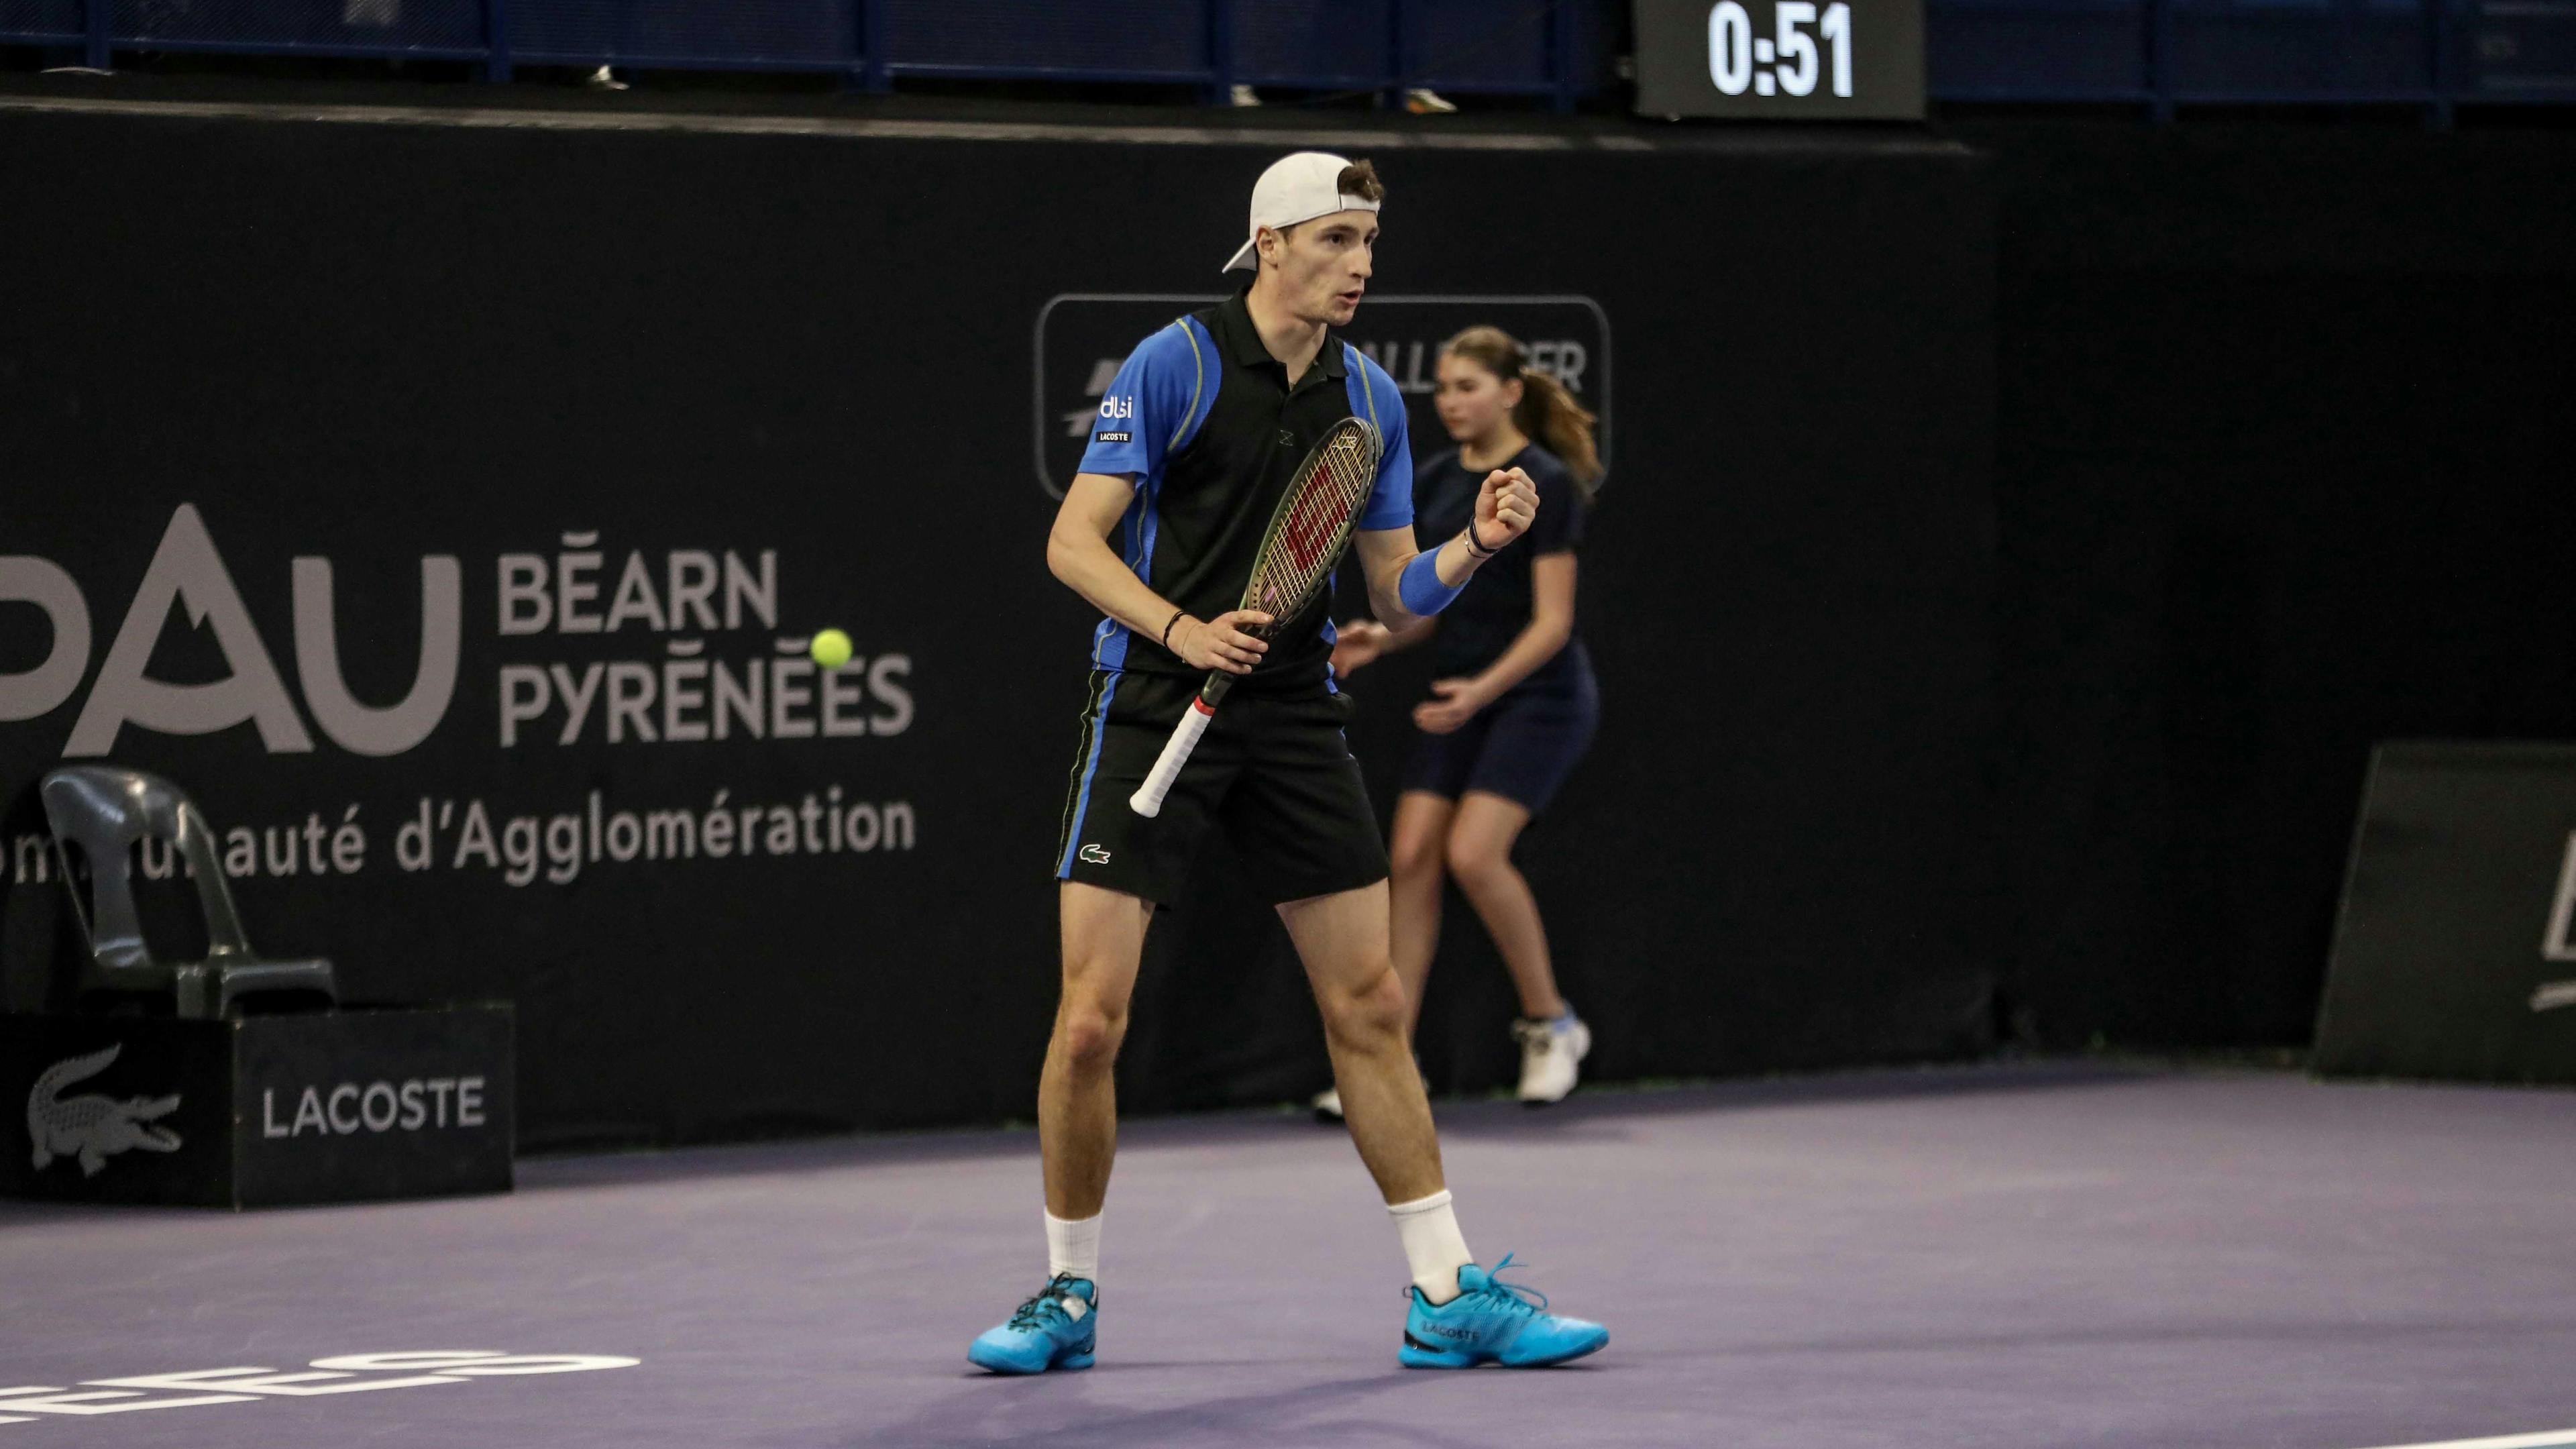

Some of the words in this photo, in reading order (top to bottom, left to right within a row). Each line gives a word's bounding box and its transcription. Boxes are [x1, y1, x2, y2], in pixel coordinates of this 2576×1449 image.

[1708, 0, 1853, 97] 0:51
[1099, 433, 1128, 441] LACOSTE
[263, 1077, 485, 1138] LACOSTE
[0, 1349, 641, 1424] EES
